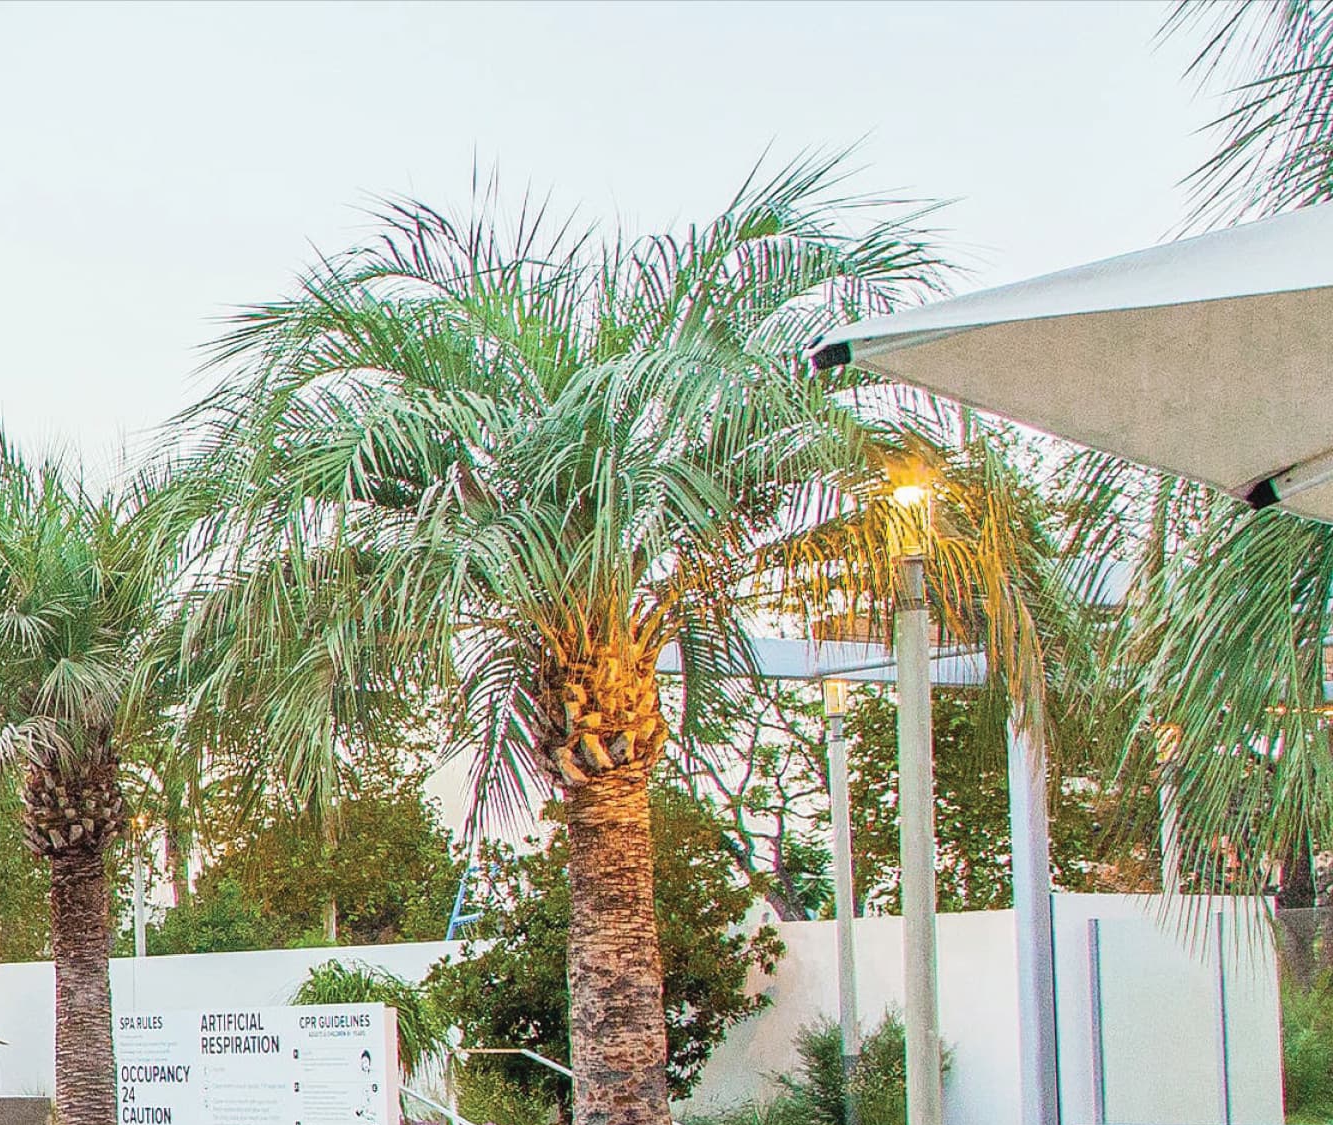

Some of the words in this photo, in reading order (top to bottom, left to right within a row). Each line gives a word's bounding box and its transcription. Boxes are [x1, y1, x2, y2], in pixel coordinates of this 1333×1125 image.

[120, 1017, 135, 1031] SPA
[137, 1016, 163, 1030] RULES
[201, 1012, 264, 1032] ARTIFICIAL
[299, 1016, 316, 1029] CPR
[318, 1014, 370, 1028] GUIDELINES
[201, 1035, 279, 1054] RESPIRATION
[121, 1065, 190, 1083] OCCUPANCY
[122, 1086, 135, 1103] 24
[122, 1106, 172, 1125] CAUTION
